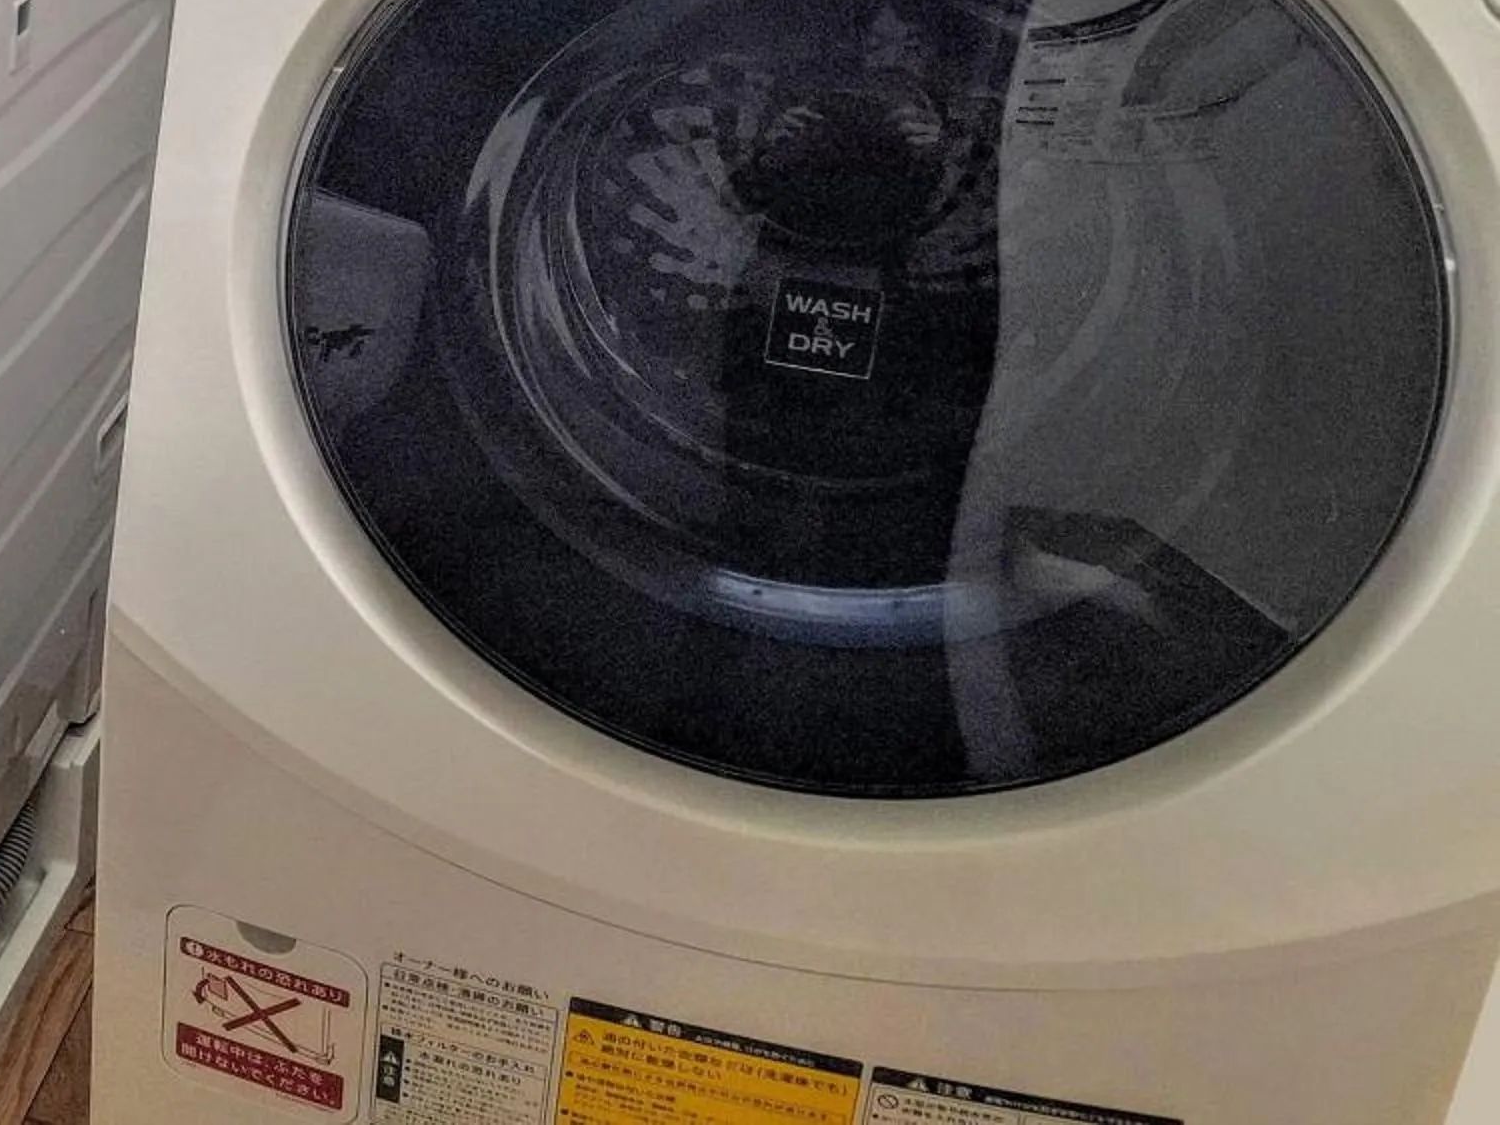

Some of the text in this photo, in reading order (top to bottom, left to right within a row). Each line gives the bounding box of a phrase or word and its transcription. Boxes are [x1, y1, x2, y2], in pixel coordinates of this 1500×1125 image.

[785, 293, 872, 324] WASH
[813, 317, 833, 338] &
[787, 332, 856, 359] DRY
